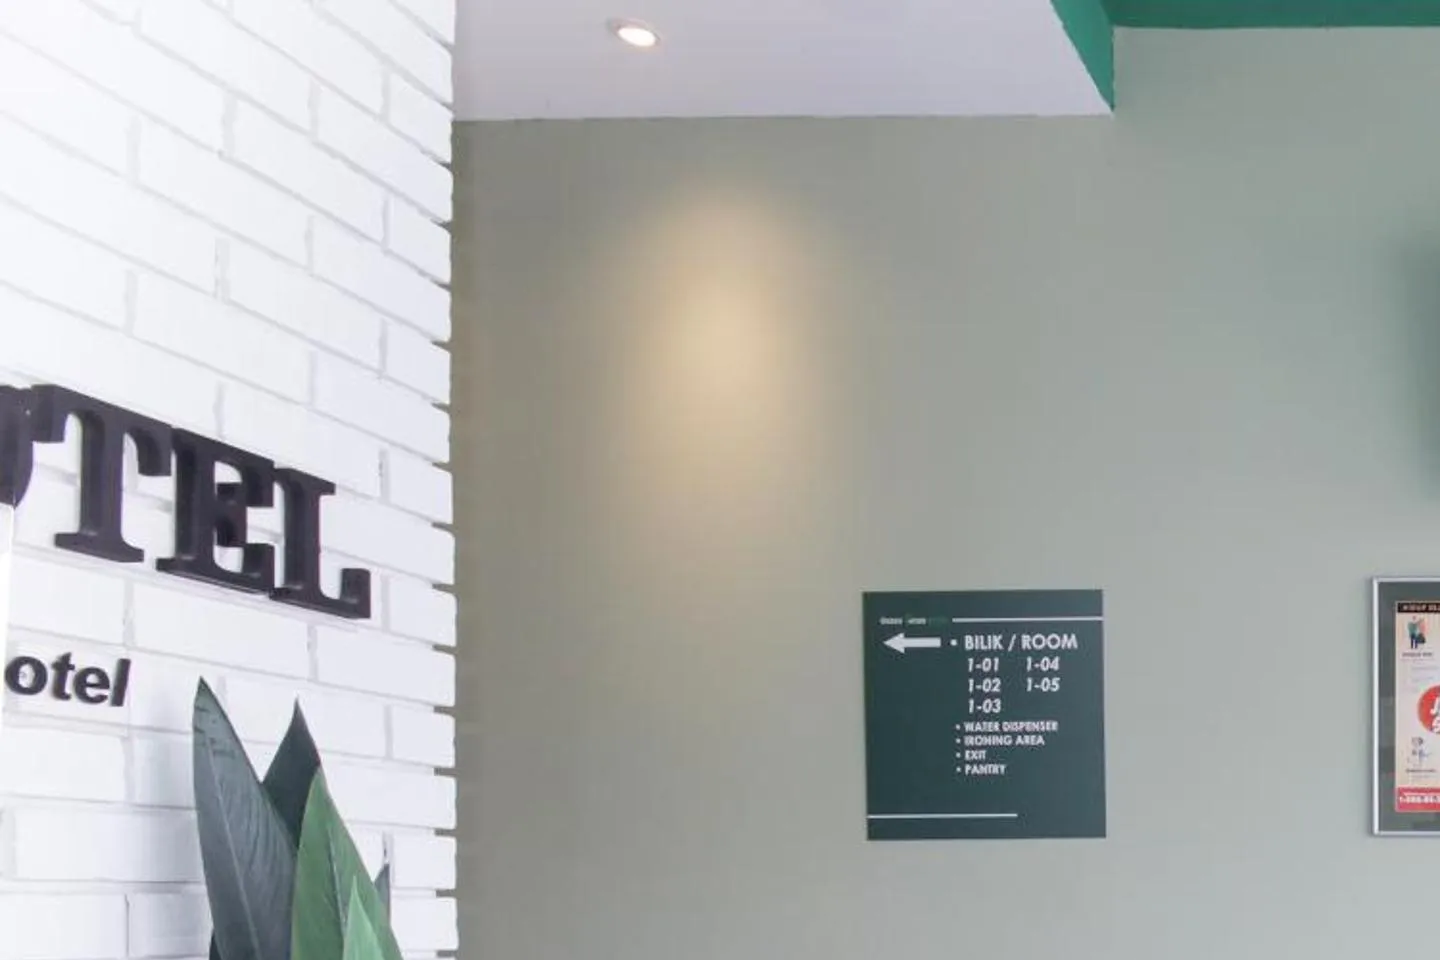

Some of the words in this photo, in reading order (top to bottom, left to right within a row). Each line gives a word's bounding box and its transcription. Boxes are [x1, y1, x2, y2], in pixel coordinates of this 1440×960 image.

[964, 635, 1003, 651] BILIK
[1020, 634, 1078, 651] ROOM
[967, 657, 1000, 673] 1-01
[1025, 656, 1060, 672] 1-04
[967, 678, 1002, 693] 1-02
[1025, 677, 1061, 692] 1-05
[968, 698, 1002, 714] 1-03
[964, 722, 1000, 732] WATER
[1002, 721, 1059, 732] DISPENSER
[964, 736, 1012, 746] IRONING
[1015, 735, 1045, 746] AREA
[964, 750, 987, 761] EXIT
[965, 764, 1007, 775] PANTRY
